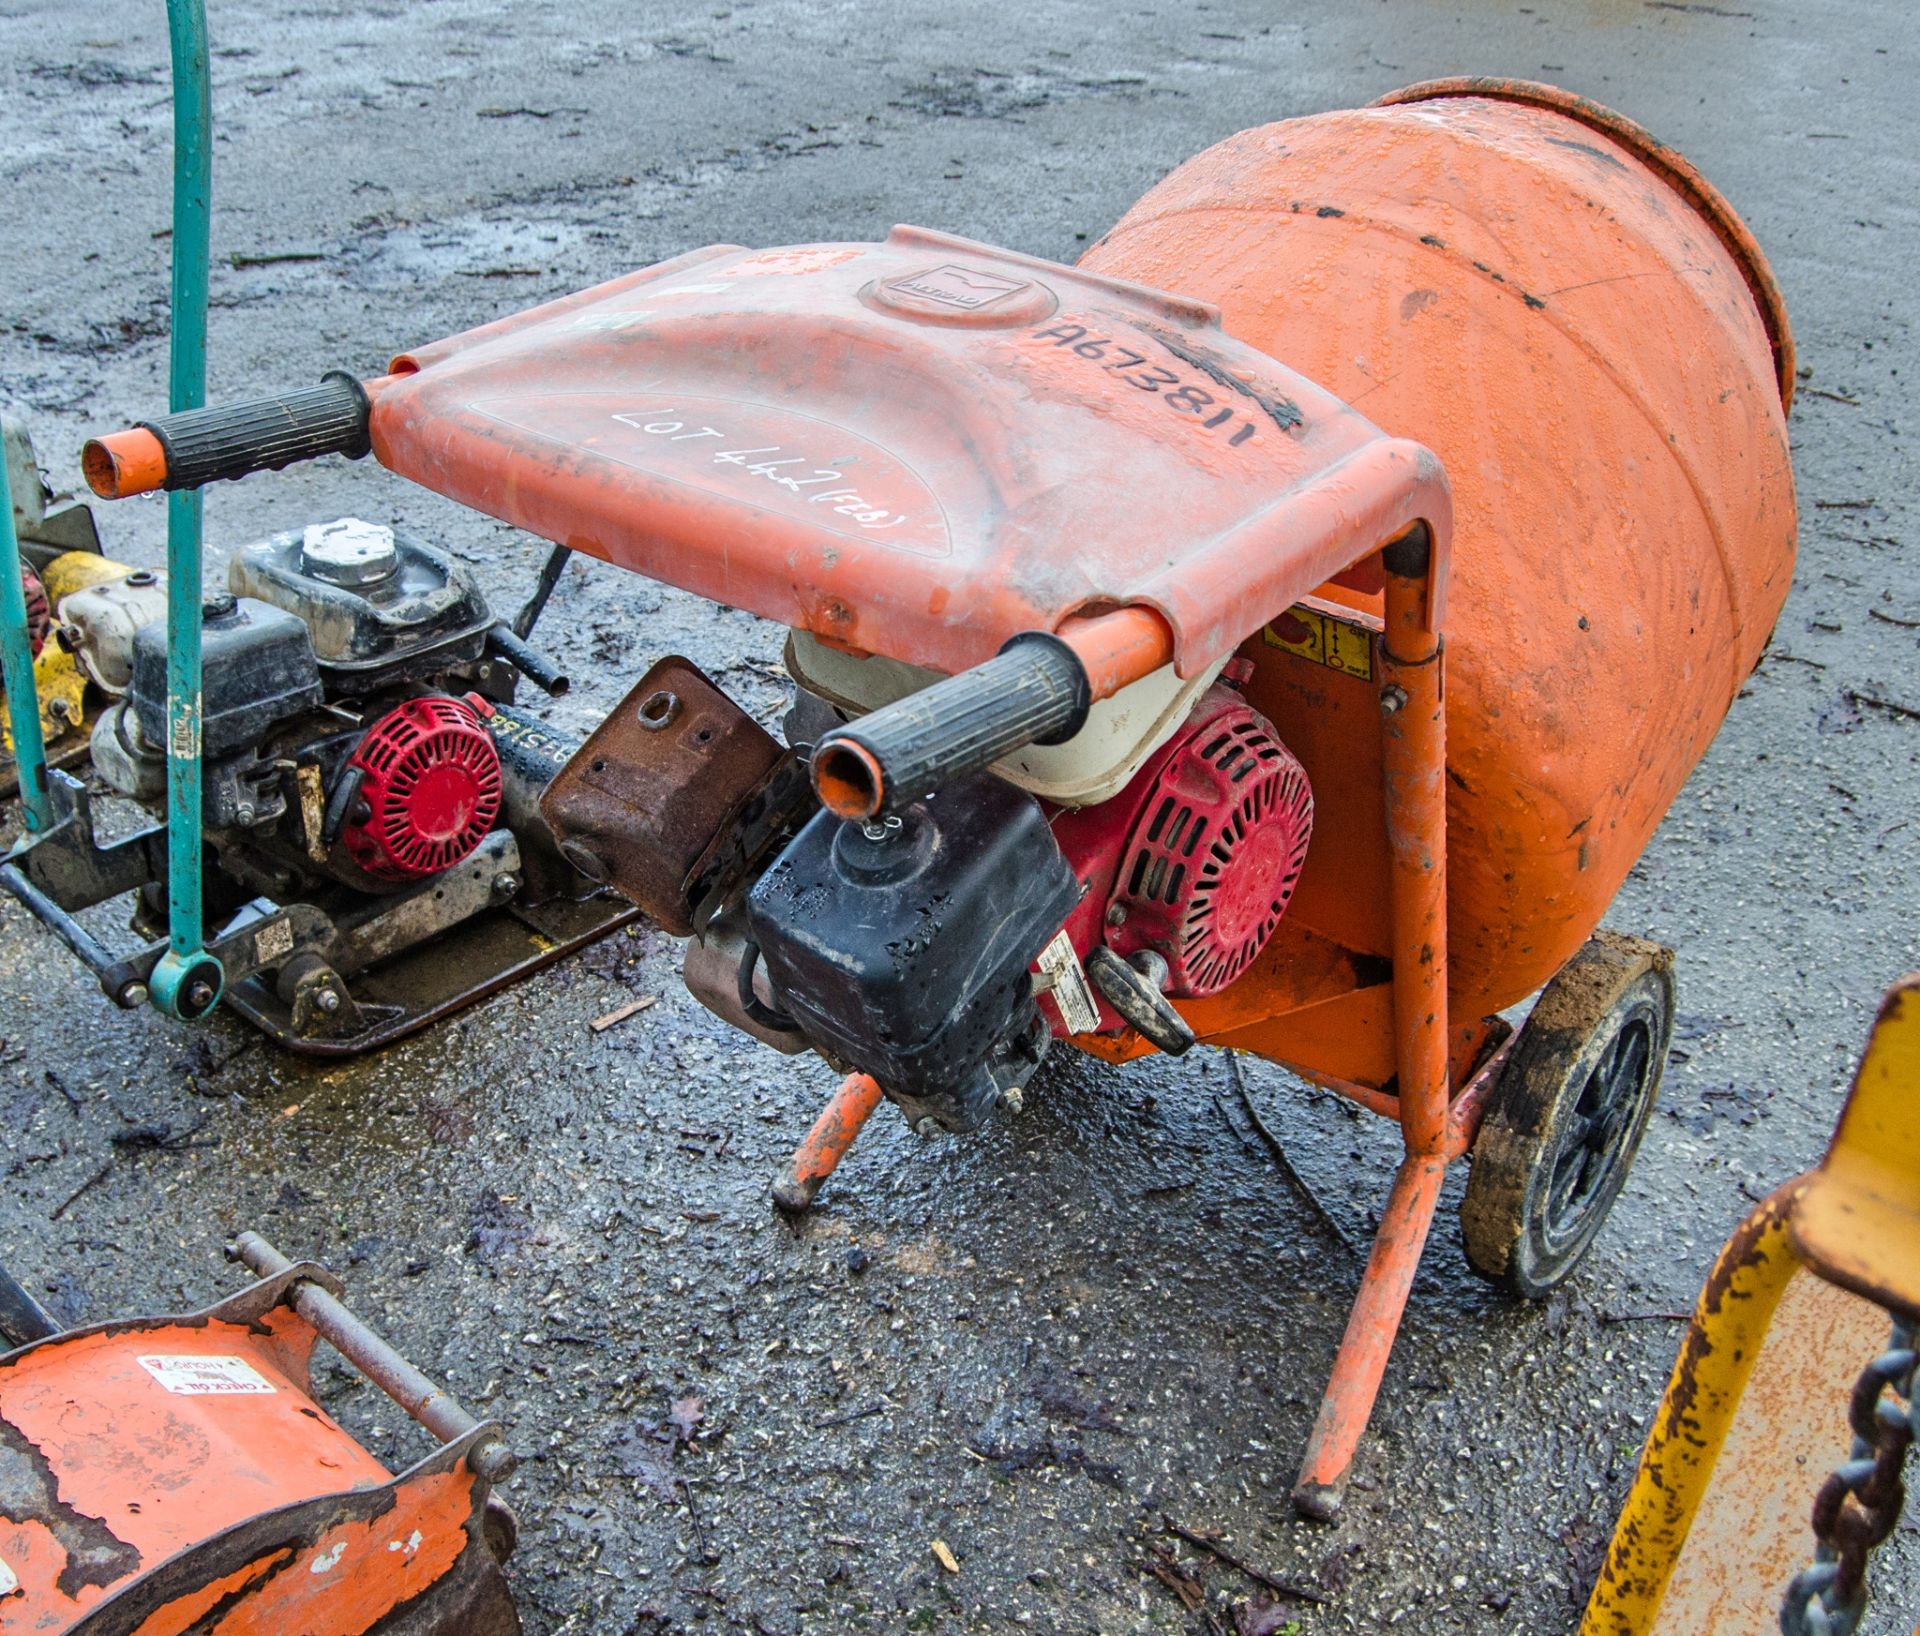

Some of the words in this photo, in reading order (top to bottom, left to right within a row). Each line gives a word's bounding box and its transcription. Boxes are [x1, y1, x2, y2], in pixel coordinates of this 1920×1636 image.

[1033, 324, 1255, 447] A673811
[611, 408, 724, 441] LOT
[214, 1382, 258, 1391] CHECK
